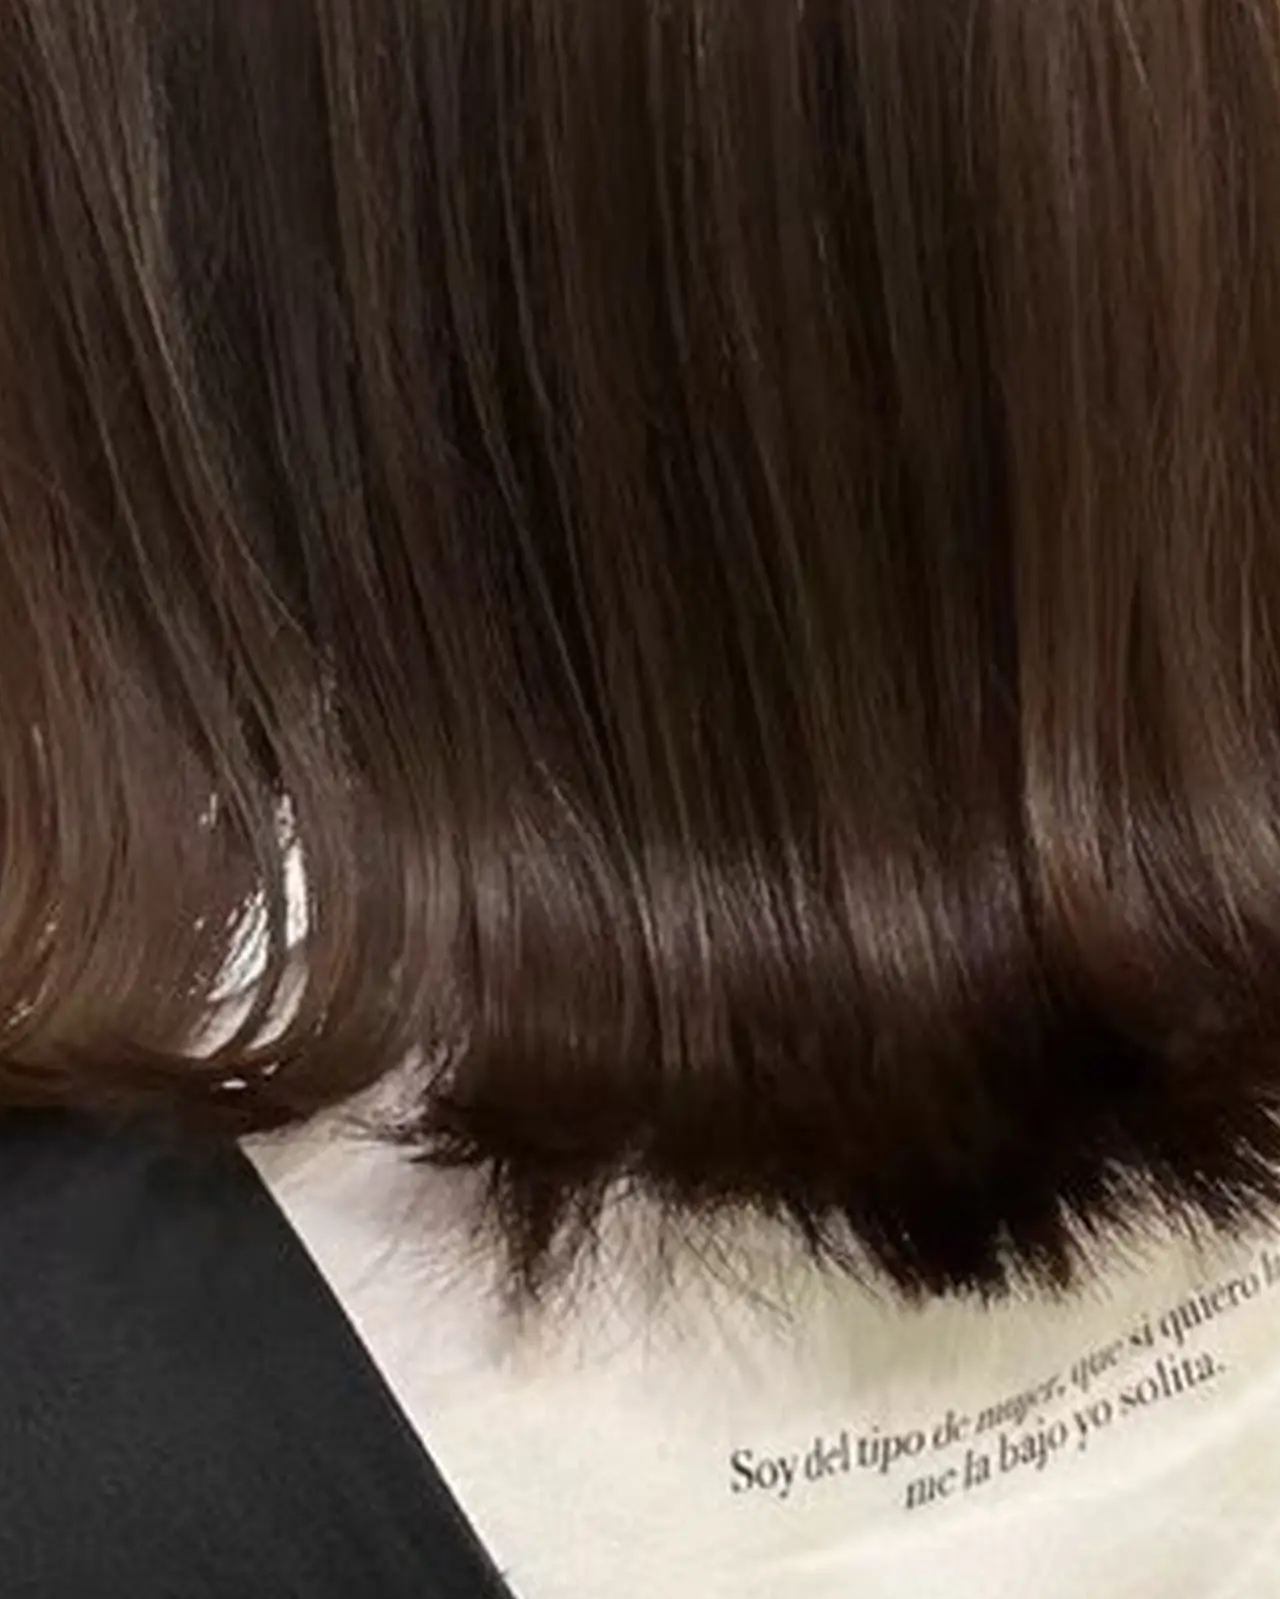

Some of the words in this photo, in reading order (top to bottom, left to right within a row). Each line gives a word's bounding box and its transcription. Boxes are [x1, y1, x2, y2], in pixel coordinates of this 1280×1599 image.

[729, 1448, 798, 1499] Soy
[804, 1429, 850, 1482] del
[857, 1425, 926, 1475] tipo
[932, 1409, 971, 1450] de
[1070, 1340, 1124, 1393] que
[1129, 1312, 1155, 1347] si
[1159, 1270, 1261, 1349] quiero
[903, 1468, 957, 1509] me
[963, 1449, 991, 1490] la
[999, 1416, 1069, 1473] bajo
[1073, 1399, 1113, 1450] yo
[1120, 1351, 1227, 1416] solita.
